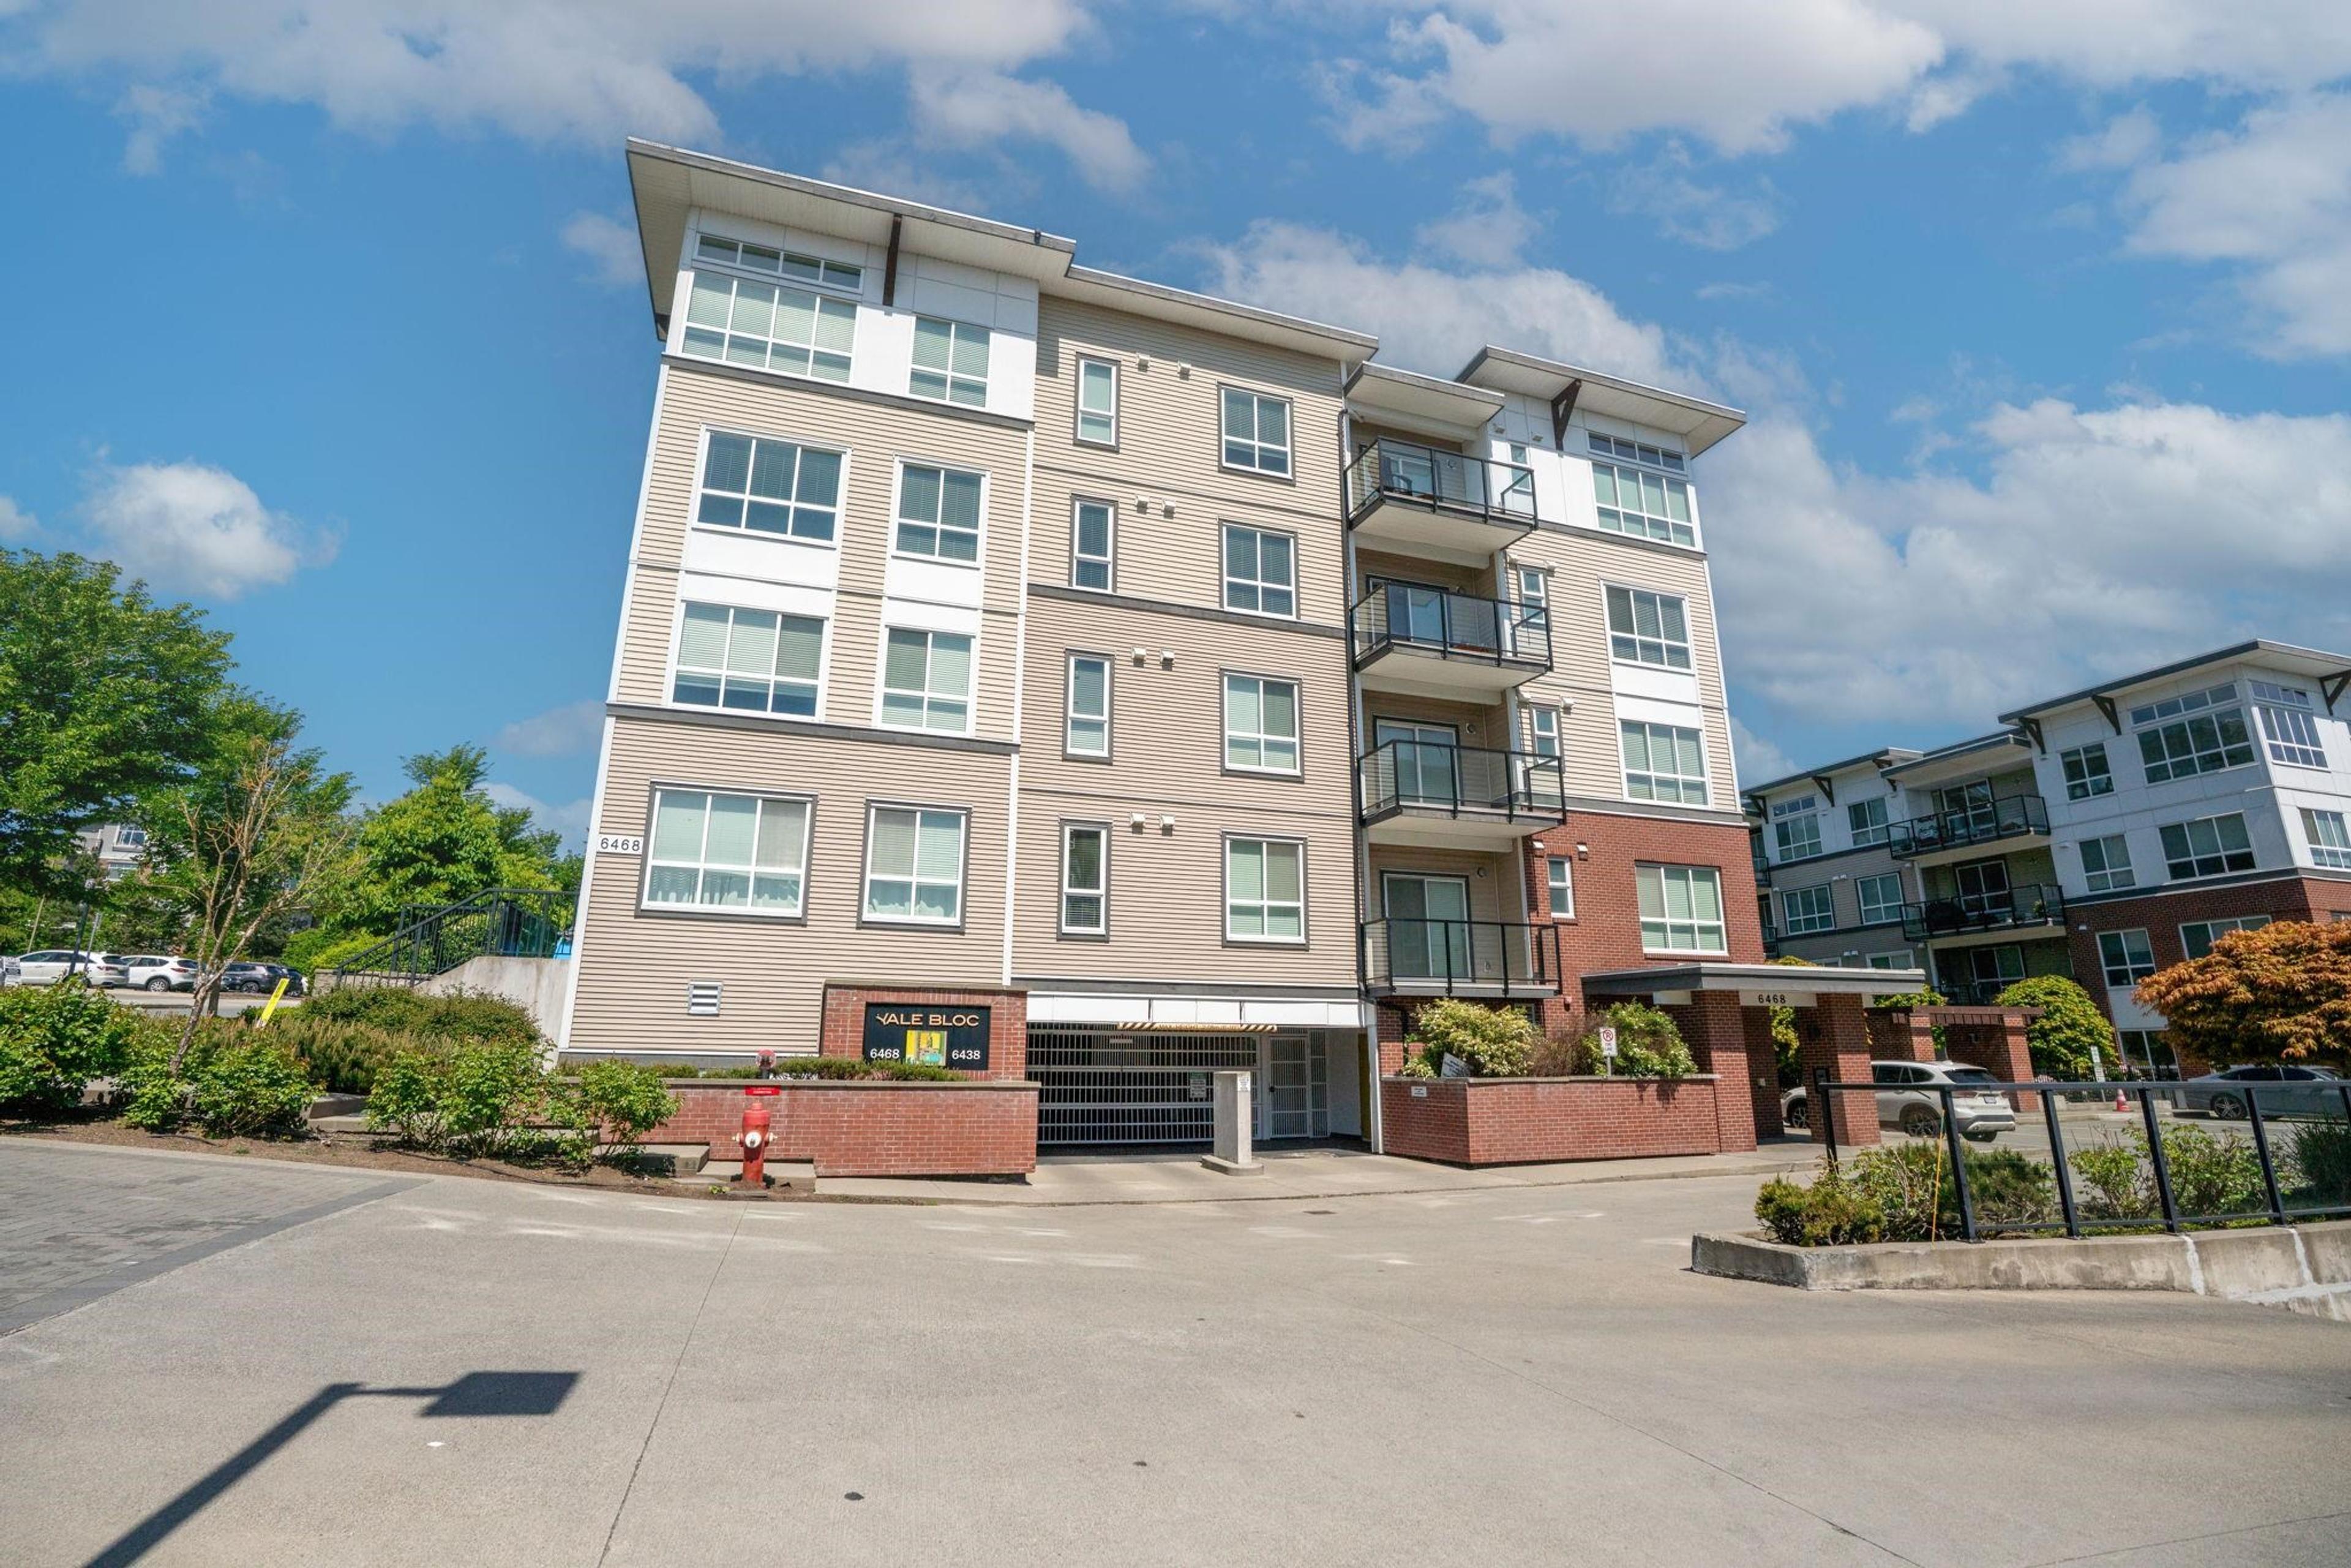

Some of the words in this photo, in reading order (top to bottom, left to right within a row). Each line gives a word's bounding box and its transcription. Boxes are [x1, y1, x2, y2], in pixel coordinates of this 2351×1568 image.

[601, 838, 640, 852] 6468
[1758, 994, 1786, 1004] 6468
[876, 1013, 923, 1026] YALE
[929, 1015, 980, 1027] BLOC
[870, 1048, 900, 1059] 6468
[951, 1049, 981, 1060] 6438
